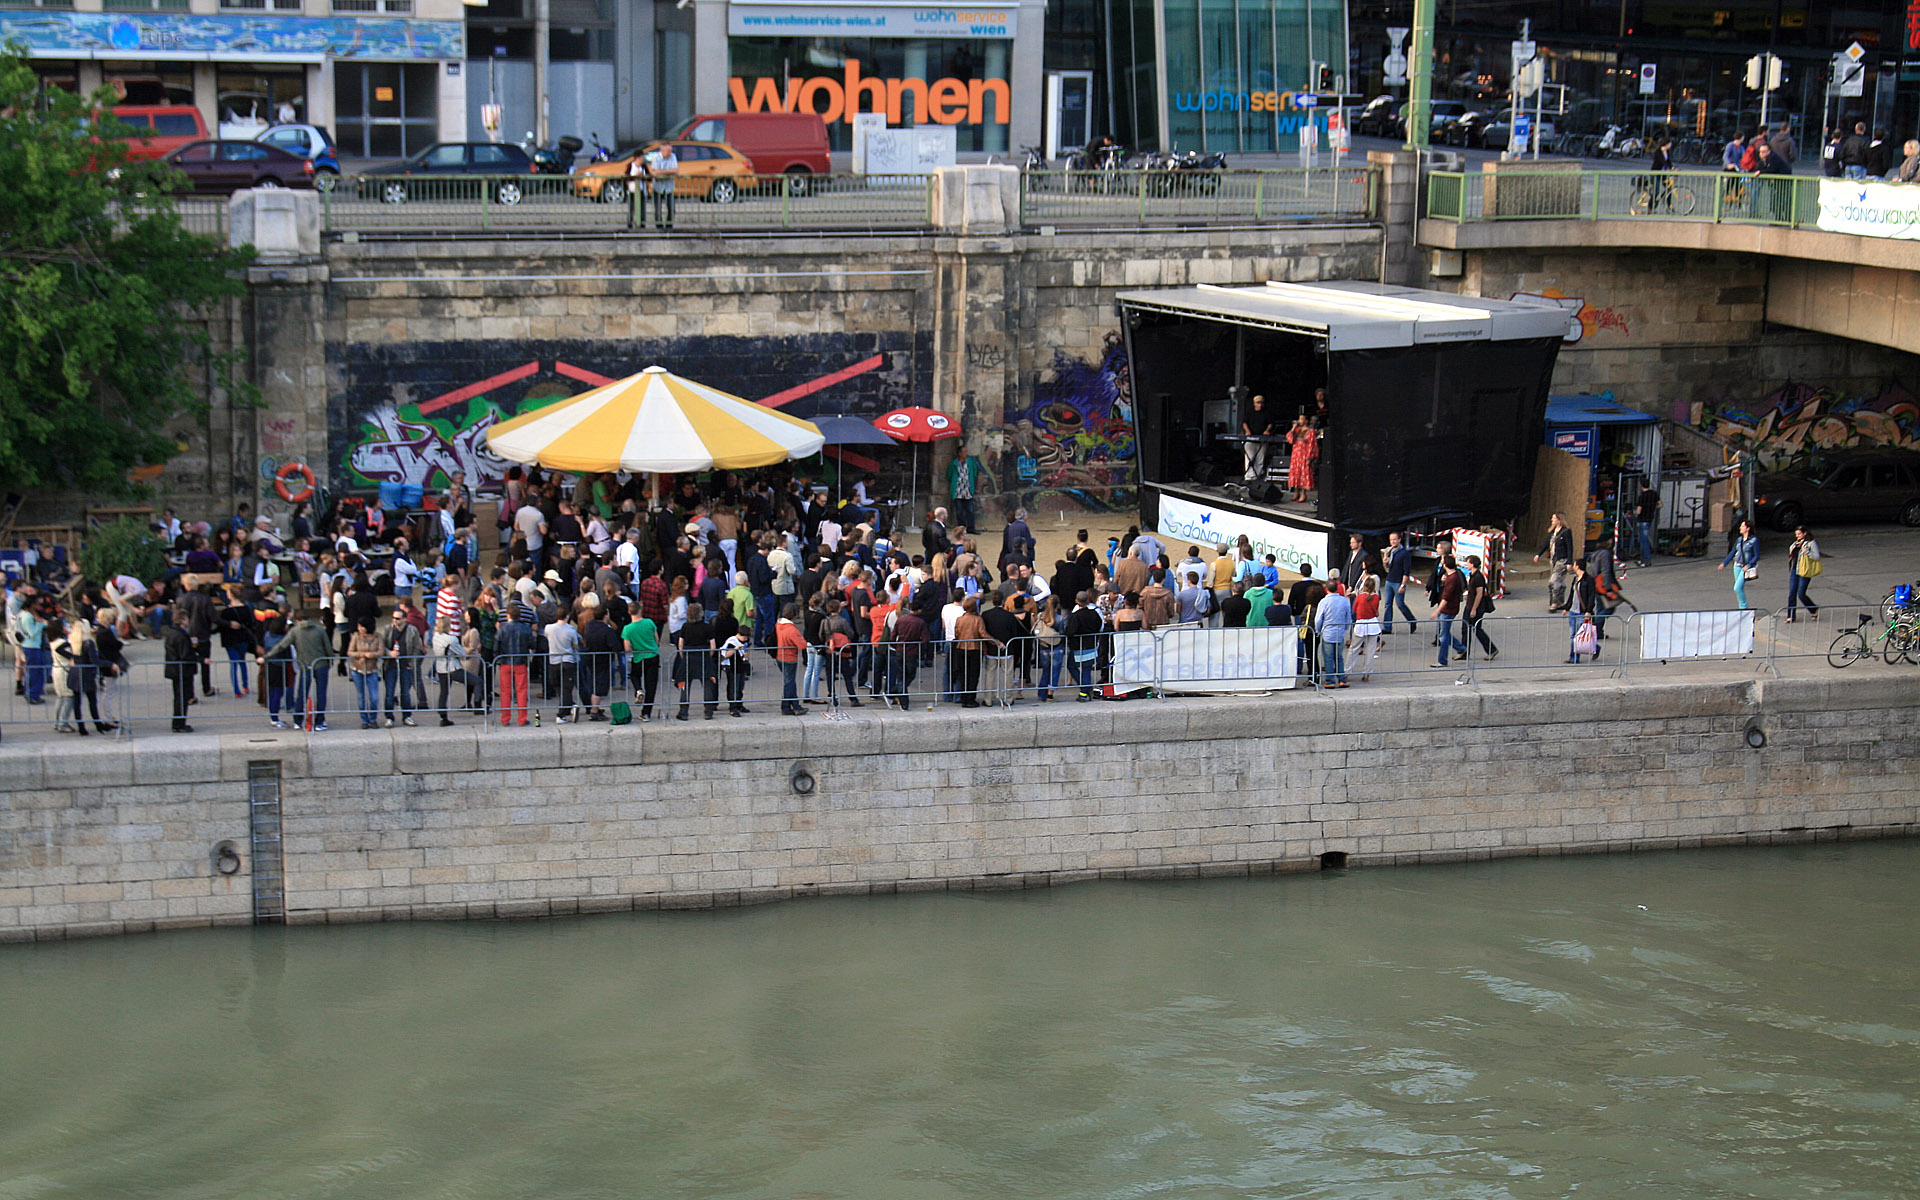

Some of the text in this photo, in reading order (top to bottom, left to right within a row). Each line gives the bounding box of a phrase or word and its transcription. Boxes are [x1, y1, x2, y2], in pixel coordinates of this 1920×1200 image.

[743, 15, 886, 26] www.wohnservice-wien.at
[914, 8, 1007, 22] wohnservice
[971, 25, 1006, 35] wien
[728, 59, 1011, 124] wohnen
